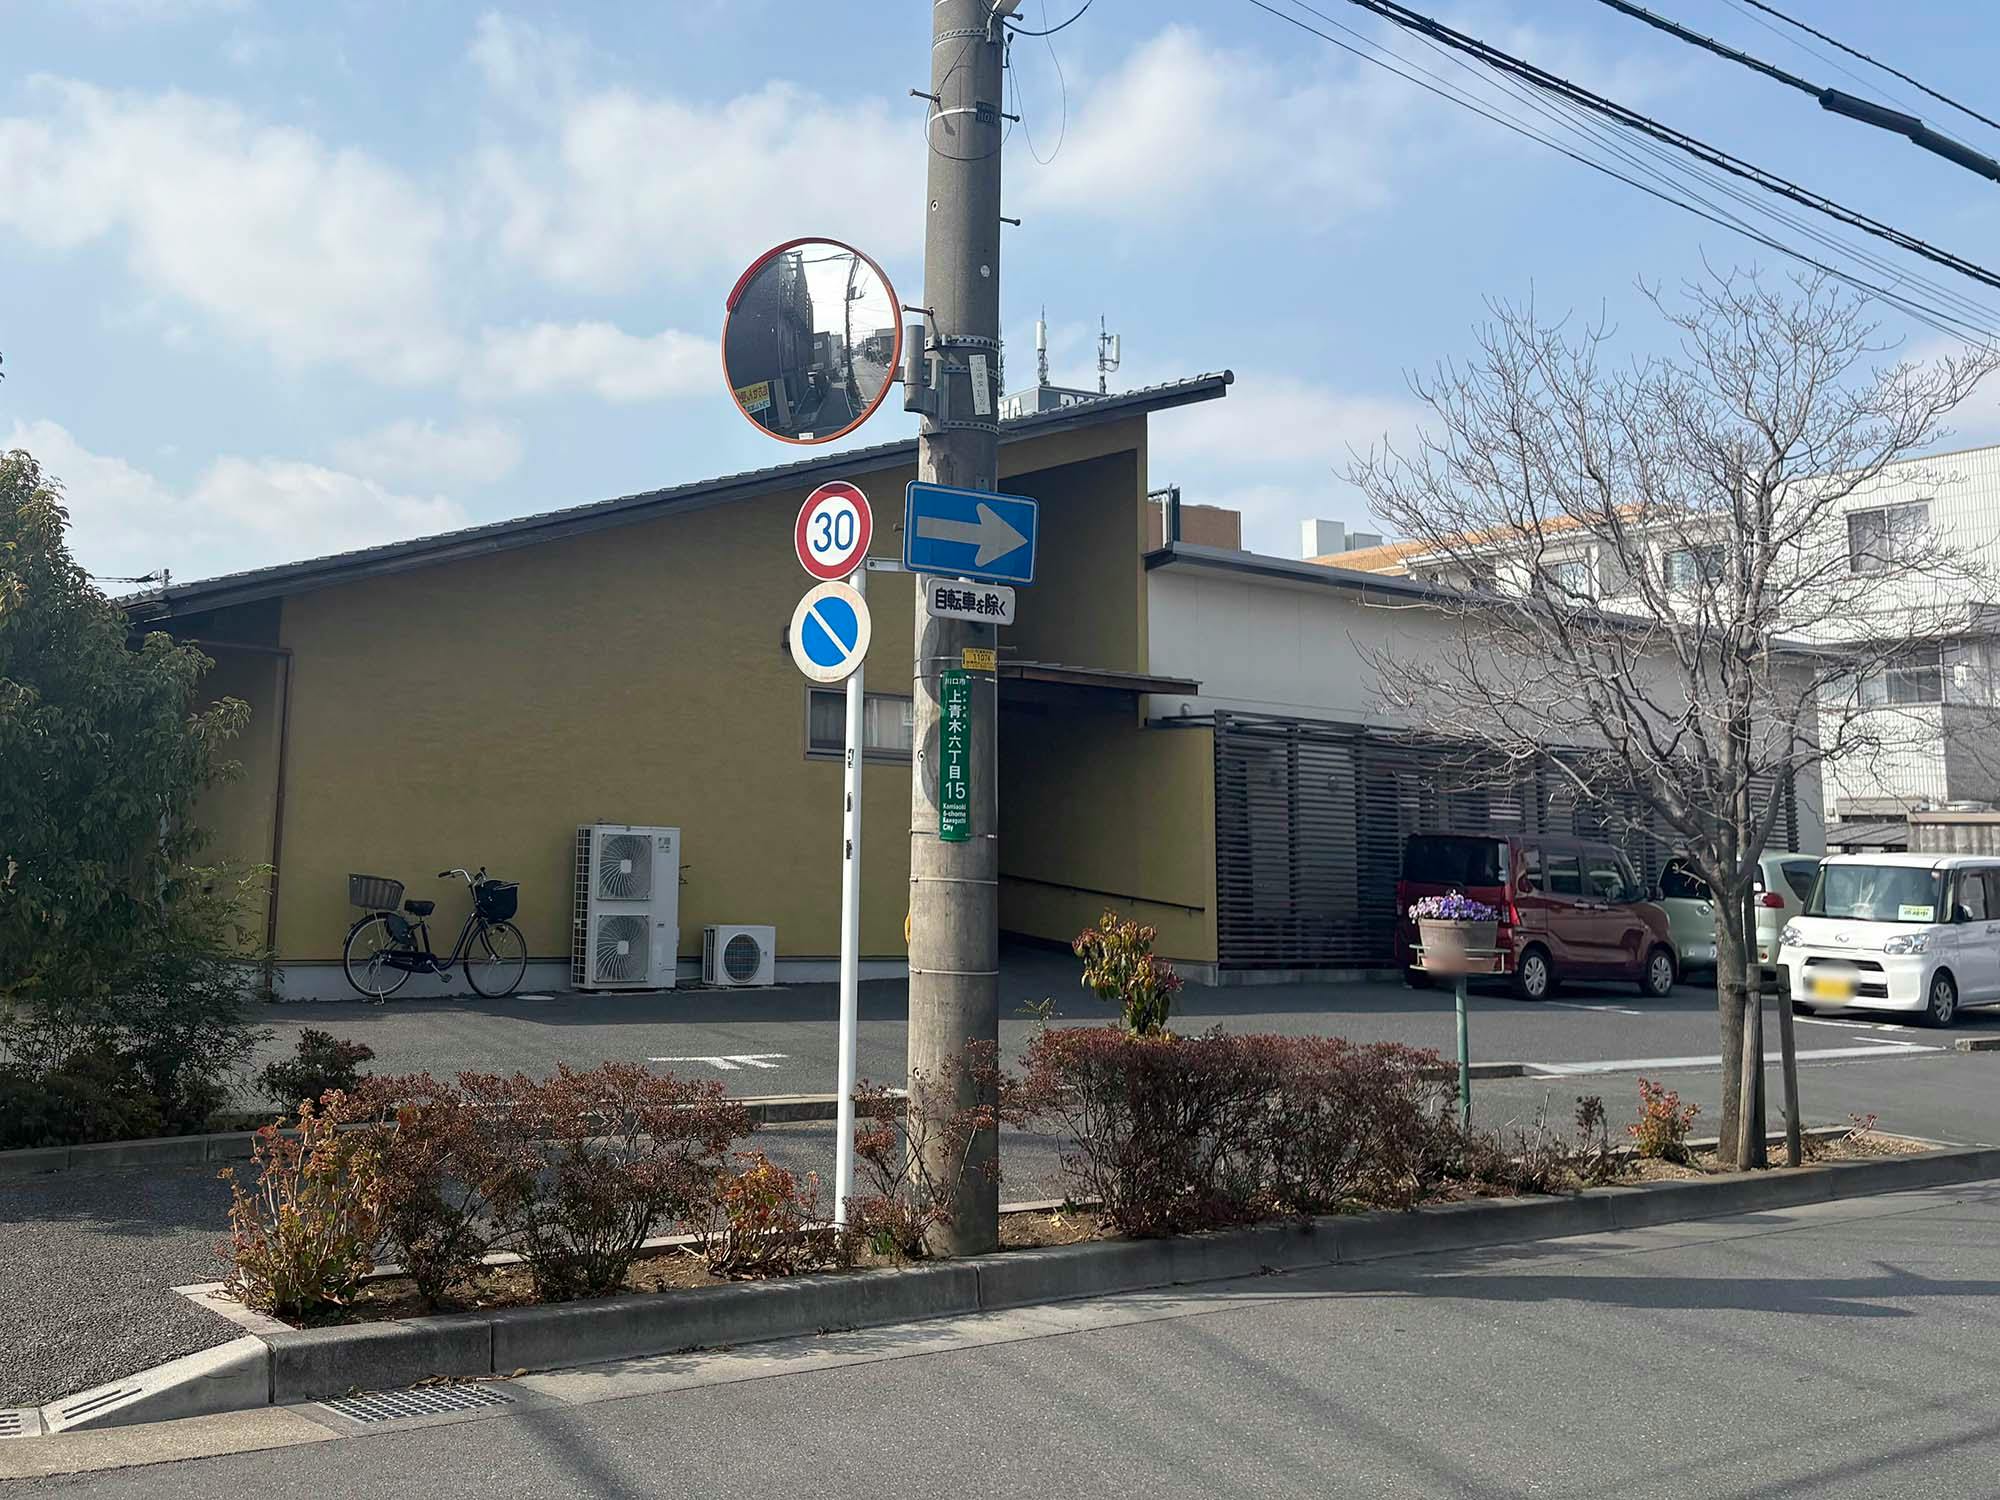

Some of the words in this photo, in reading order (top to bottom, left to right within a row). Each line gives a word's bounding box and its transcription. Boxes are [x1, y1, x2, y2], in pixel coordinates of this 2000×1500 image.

[814, 509, 854, 552] 30
[935, 587, 1006, 616] 自転車を除く
[944, 677, 966, 686] 川口市
[948, 689, 962, 779] 上青木六丁目
[945, 781, 966, 799] 15
[942, 824, 954, 832] City
